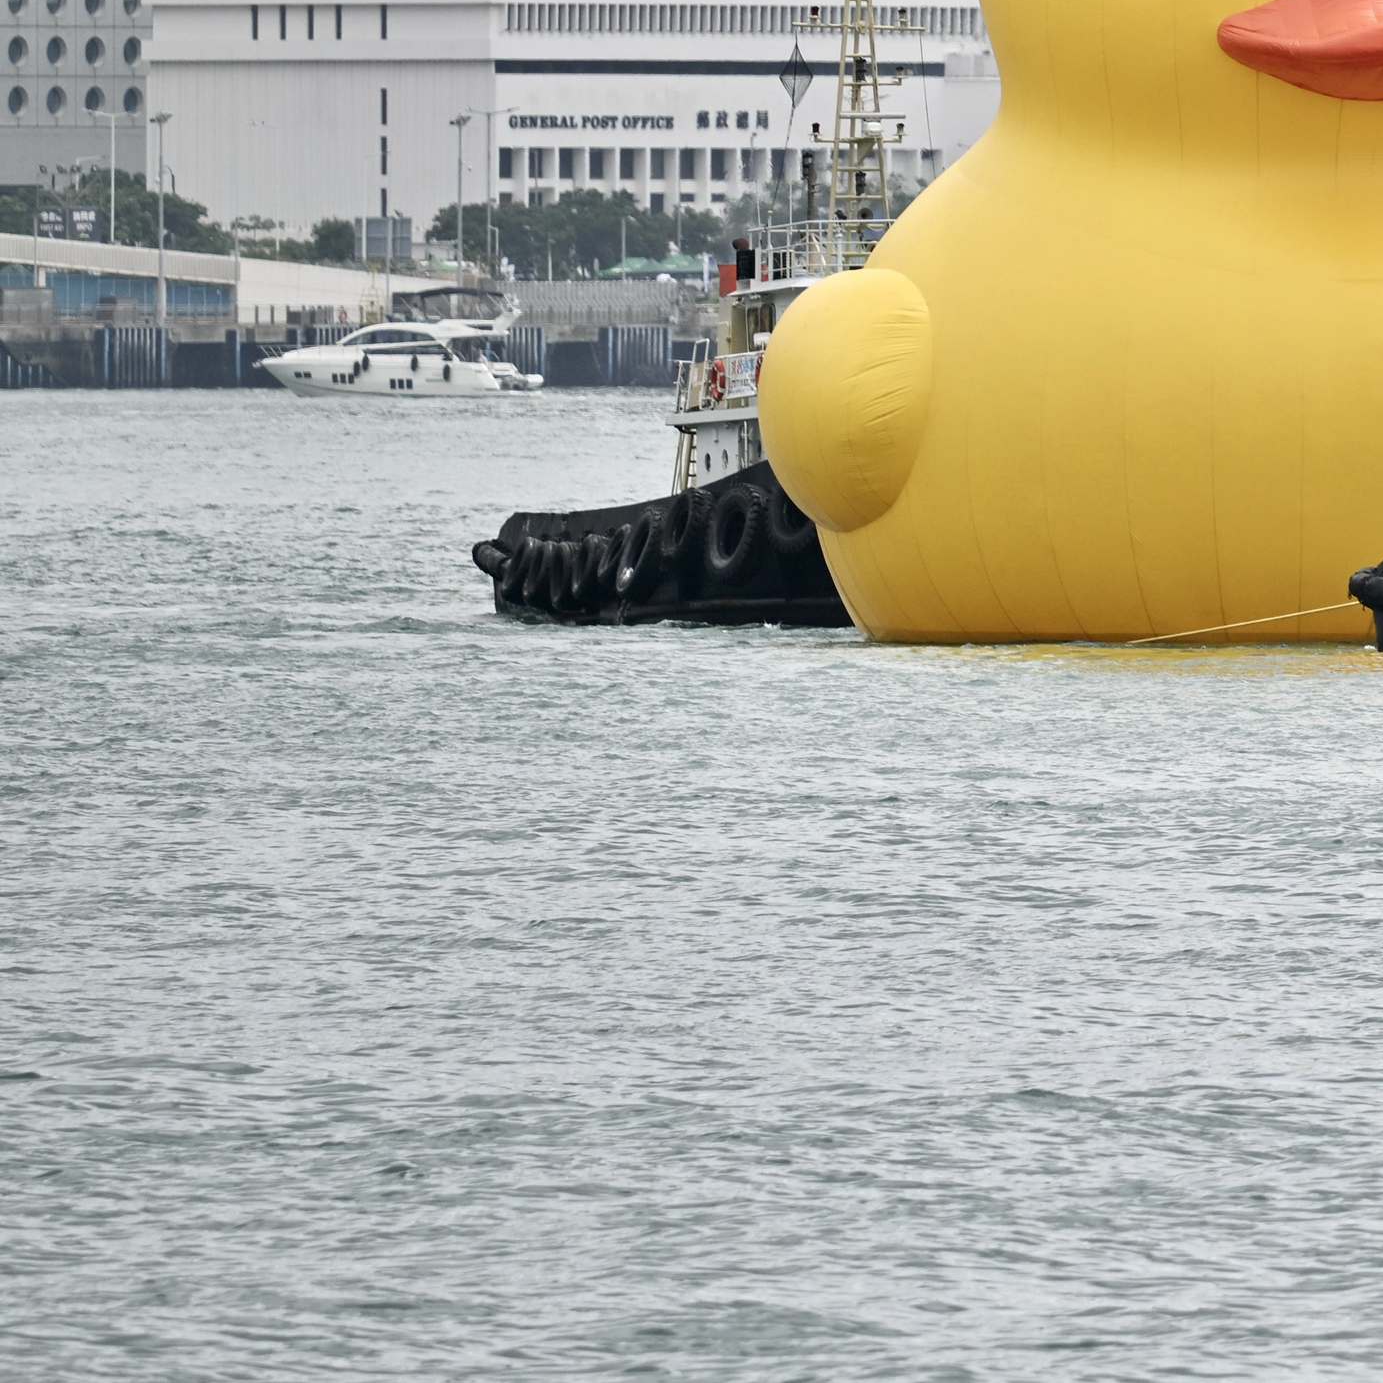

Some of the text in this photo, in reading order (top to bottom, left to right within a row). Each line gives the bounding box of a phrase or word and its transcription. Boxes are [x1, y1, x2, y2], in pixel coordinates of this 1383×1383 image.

[508, 115, 674, 129] GENERAL POST OFFICE
